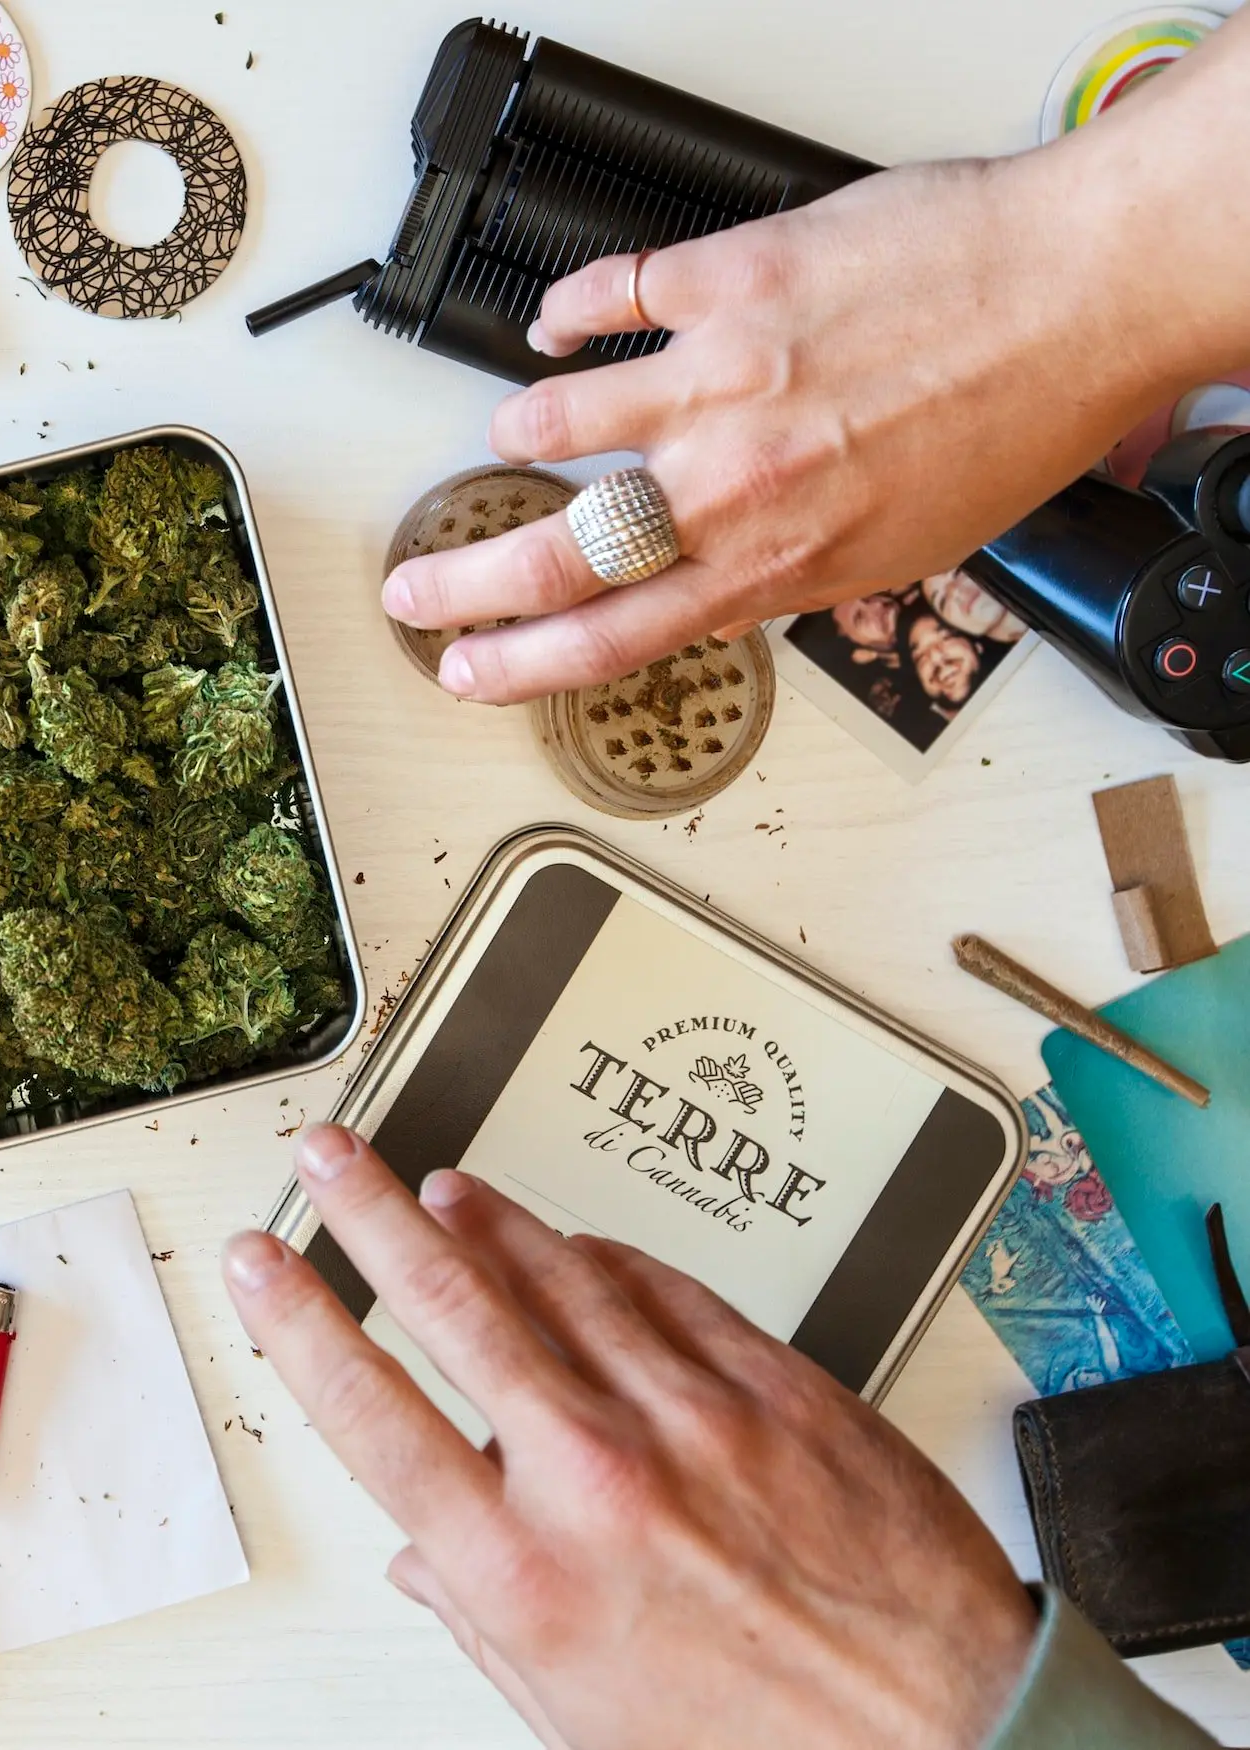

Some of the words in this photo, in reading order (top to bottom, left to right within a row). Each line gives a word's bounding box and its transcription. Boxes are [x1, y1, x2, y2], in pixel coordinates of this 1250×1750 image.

[570, 1040, 826, 1227] TERRE
[642, 1016, 757, 1052] PREMIUM
[764, 1040, 805, 1142] QUALITY
[583, 1119, 643, 1151] di
[627, 1146, 765, 1232] Cannabis
